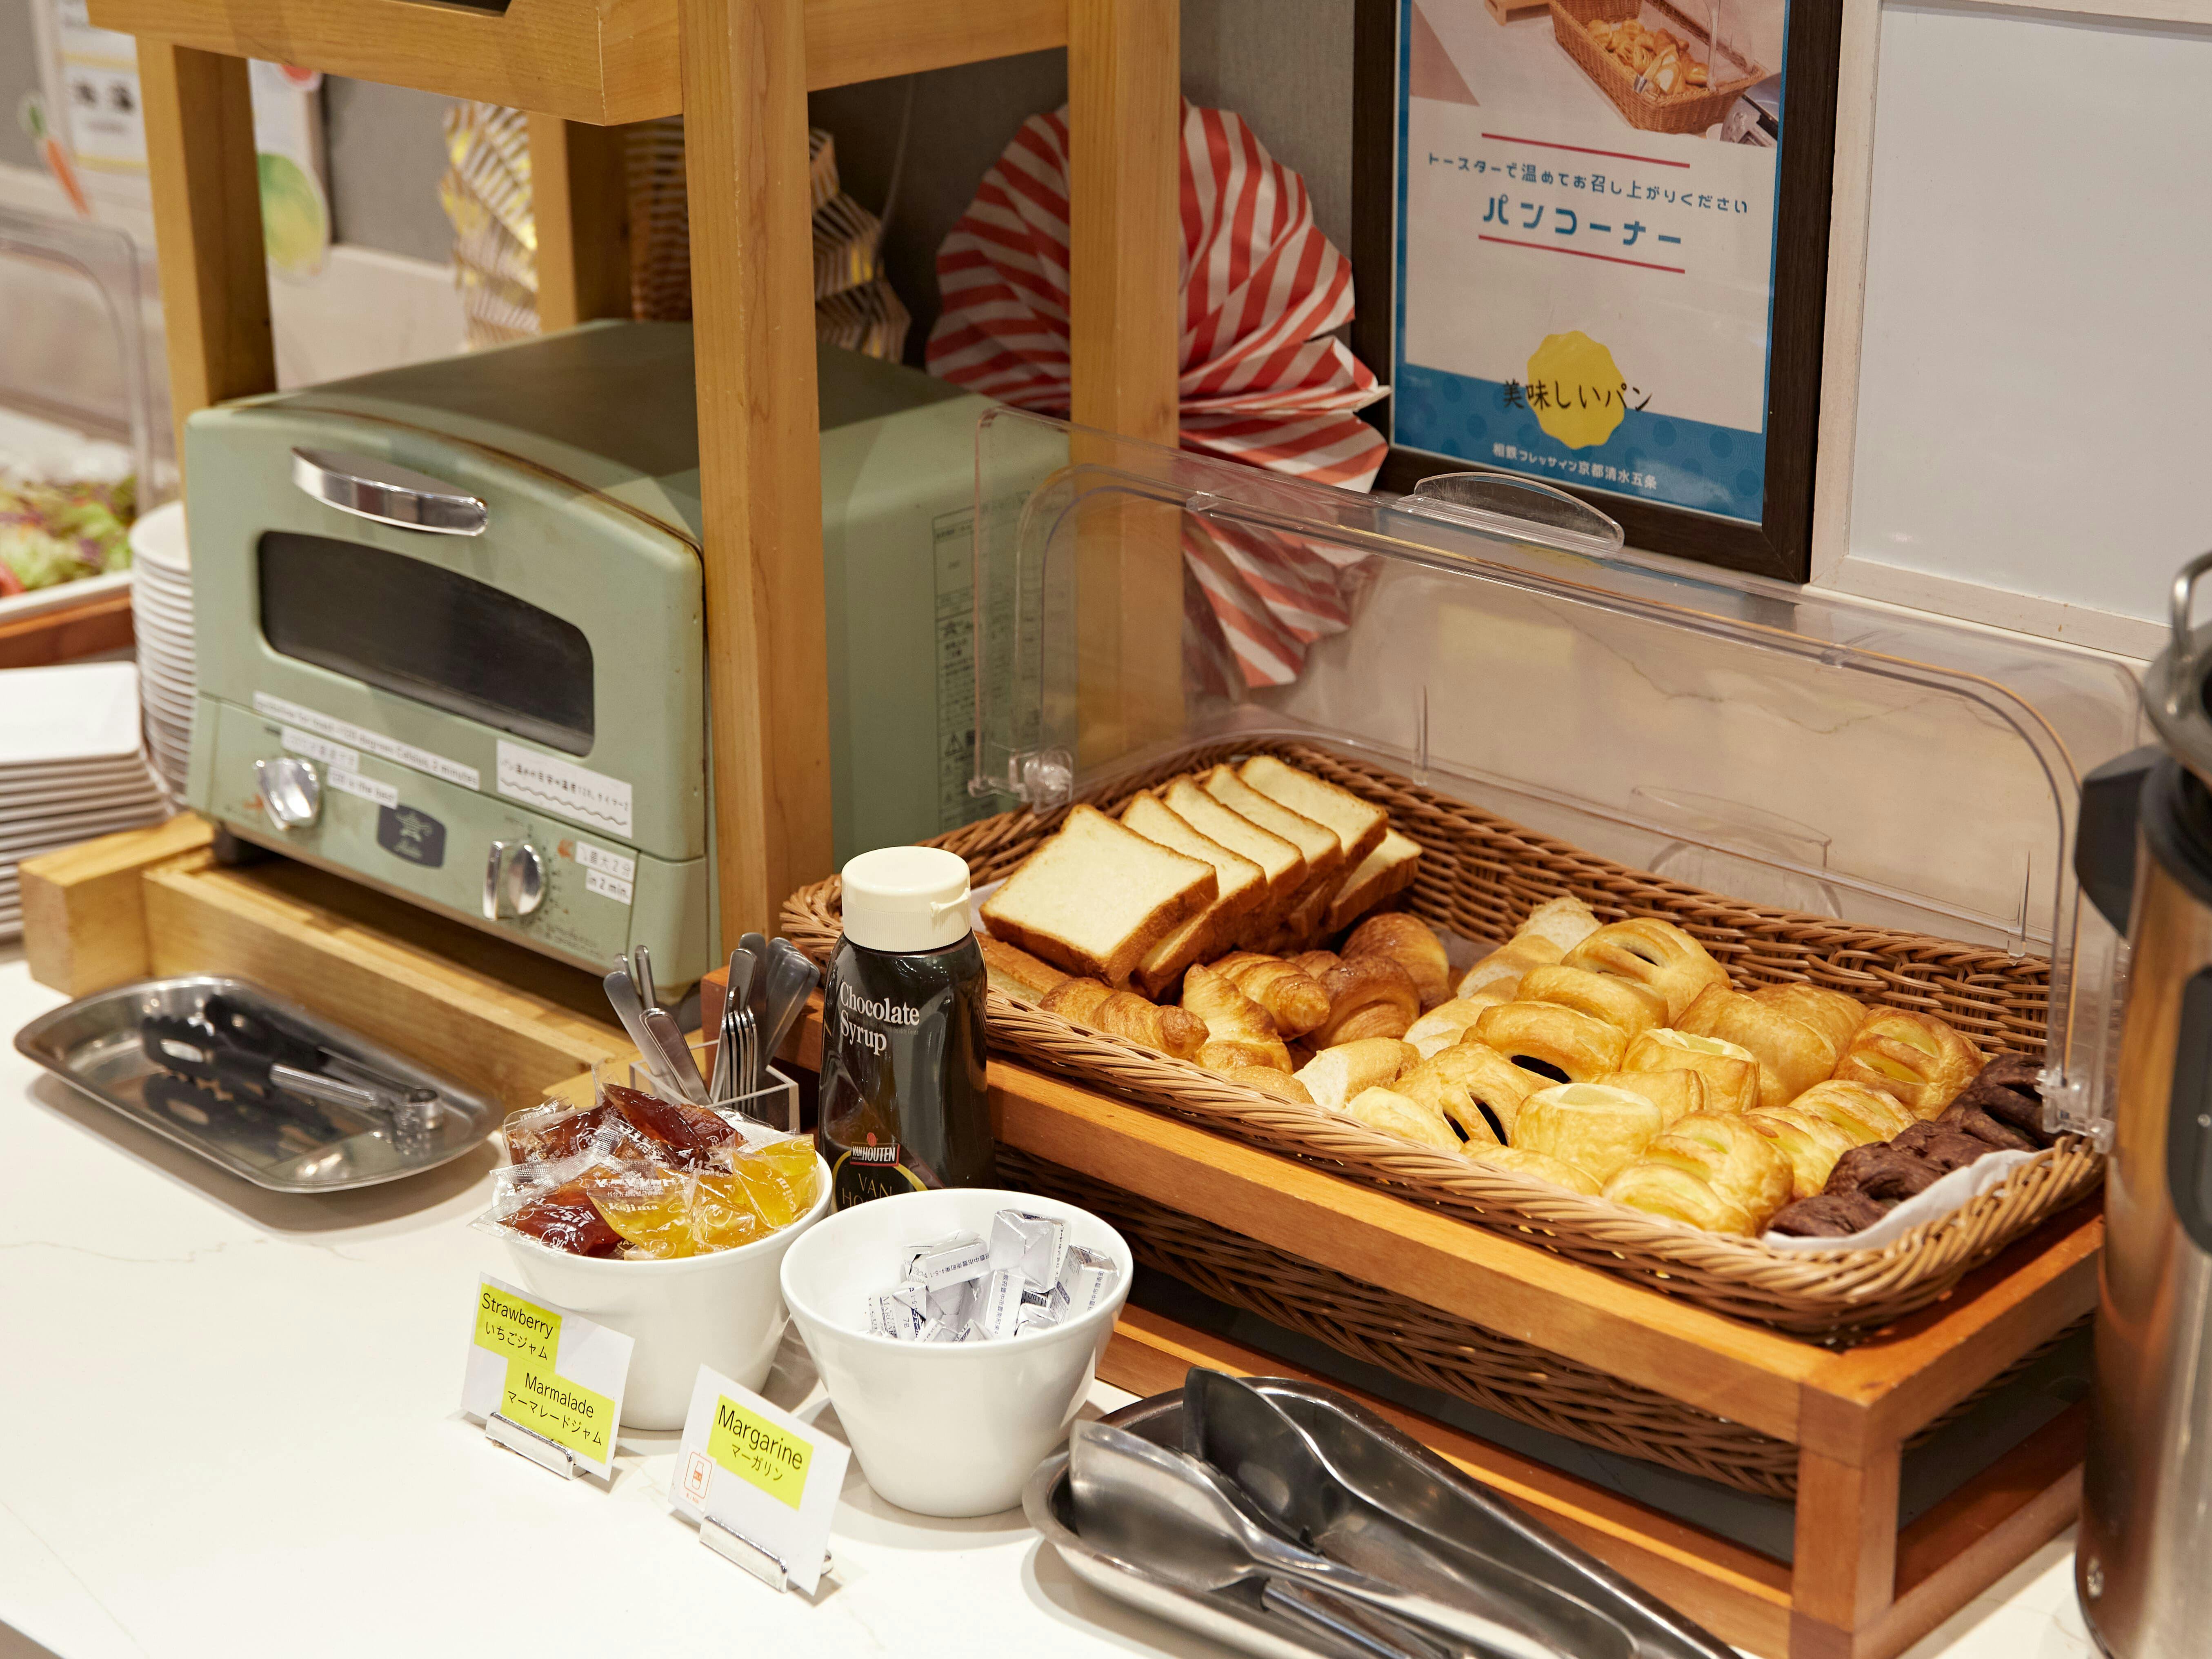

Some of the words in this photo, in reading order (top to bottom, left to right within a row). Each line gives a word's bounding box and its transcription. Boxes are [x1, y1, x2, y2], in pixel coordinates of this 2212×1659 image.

[1428, 153, 1748, 215] トースターで温めてお召し上がりください
[1483, 194, 1682, 246] パンコーナー
[1502, 378, 1653, 412] 美味しいパン
[599, 877, 605, 890] 2
[840, 982, 920, 1026] Chocolate
[841, 1009, 887, 1056] Syrup
[852, 1146, 863, 1157] VAN
[862, 1147, 896, 1162] HOUTEN
[842, 1188, 868, 1207] HO
[858, 1173, 892, 1198] VAN
[608, 1202, 659, 1213] Kojima
[481, 1293, 553, 1339] Strawberry
[486, 1321, 547, 1360] いちごジャム
[525, 1372, 594, 1418] Marmalade
[508, 1390, 602, 1446] マーマレードジャム
[718, 1405, 802, 1470] Margarine
[732, 1444, 783, 1481] マーガリン
